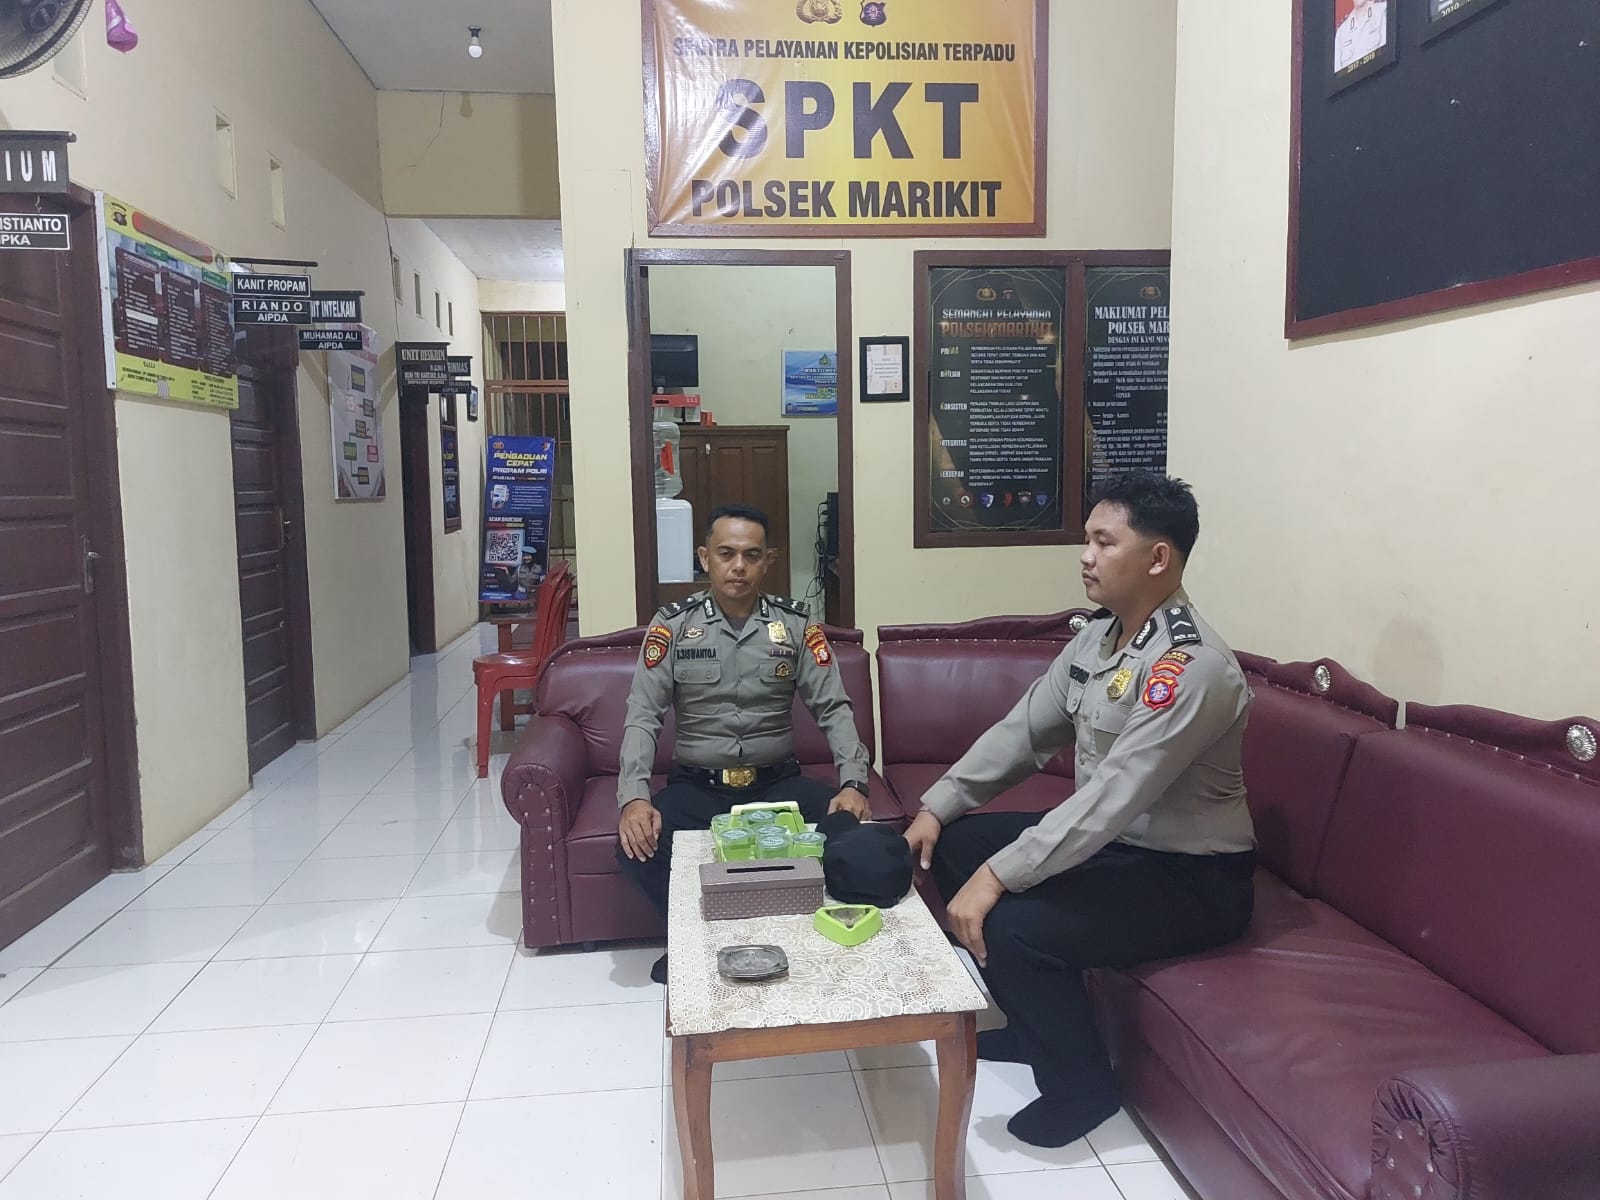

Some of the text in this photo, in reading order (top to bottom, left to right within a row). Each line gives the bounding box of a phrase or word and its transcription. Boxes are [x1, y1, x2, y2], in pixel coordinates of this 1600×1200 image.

[673, 37, 1015, 62] SENTRA PELAYANAN KEPOLISIAN TERPADU
[717, 78, 979, 160] SPKT
[691, 180, 1002, 218] POLSEK MARIKIT
[0, 234, 31, 245] PKA
[237, 278, 306, 292] KANIT PROPAM
[241, 300, 303, 311] RIANDO
[321, 300, 356, 318] INTELKAM
[257, 313, 288, 322] AIPDA
[1095, 306, 1147, 319] MAKLUMAT
[1108, 321, 1146, 334] POLSEK
[303, 331, 358, 340] MUHAMAD ALI
[318, 342, 344, 350] AIPDA
